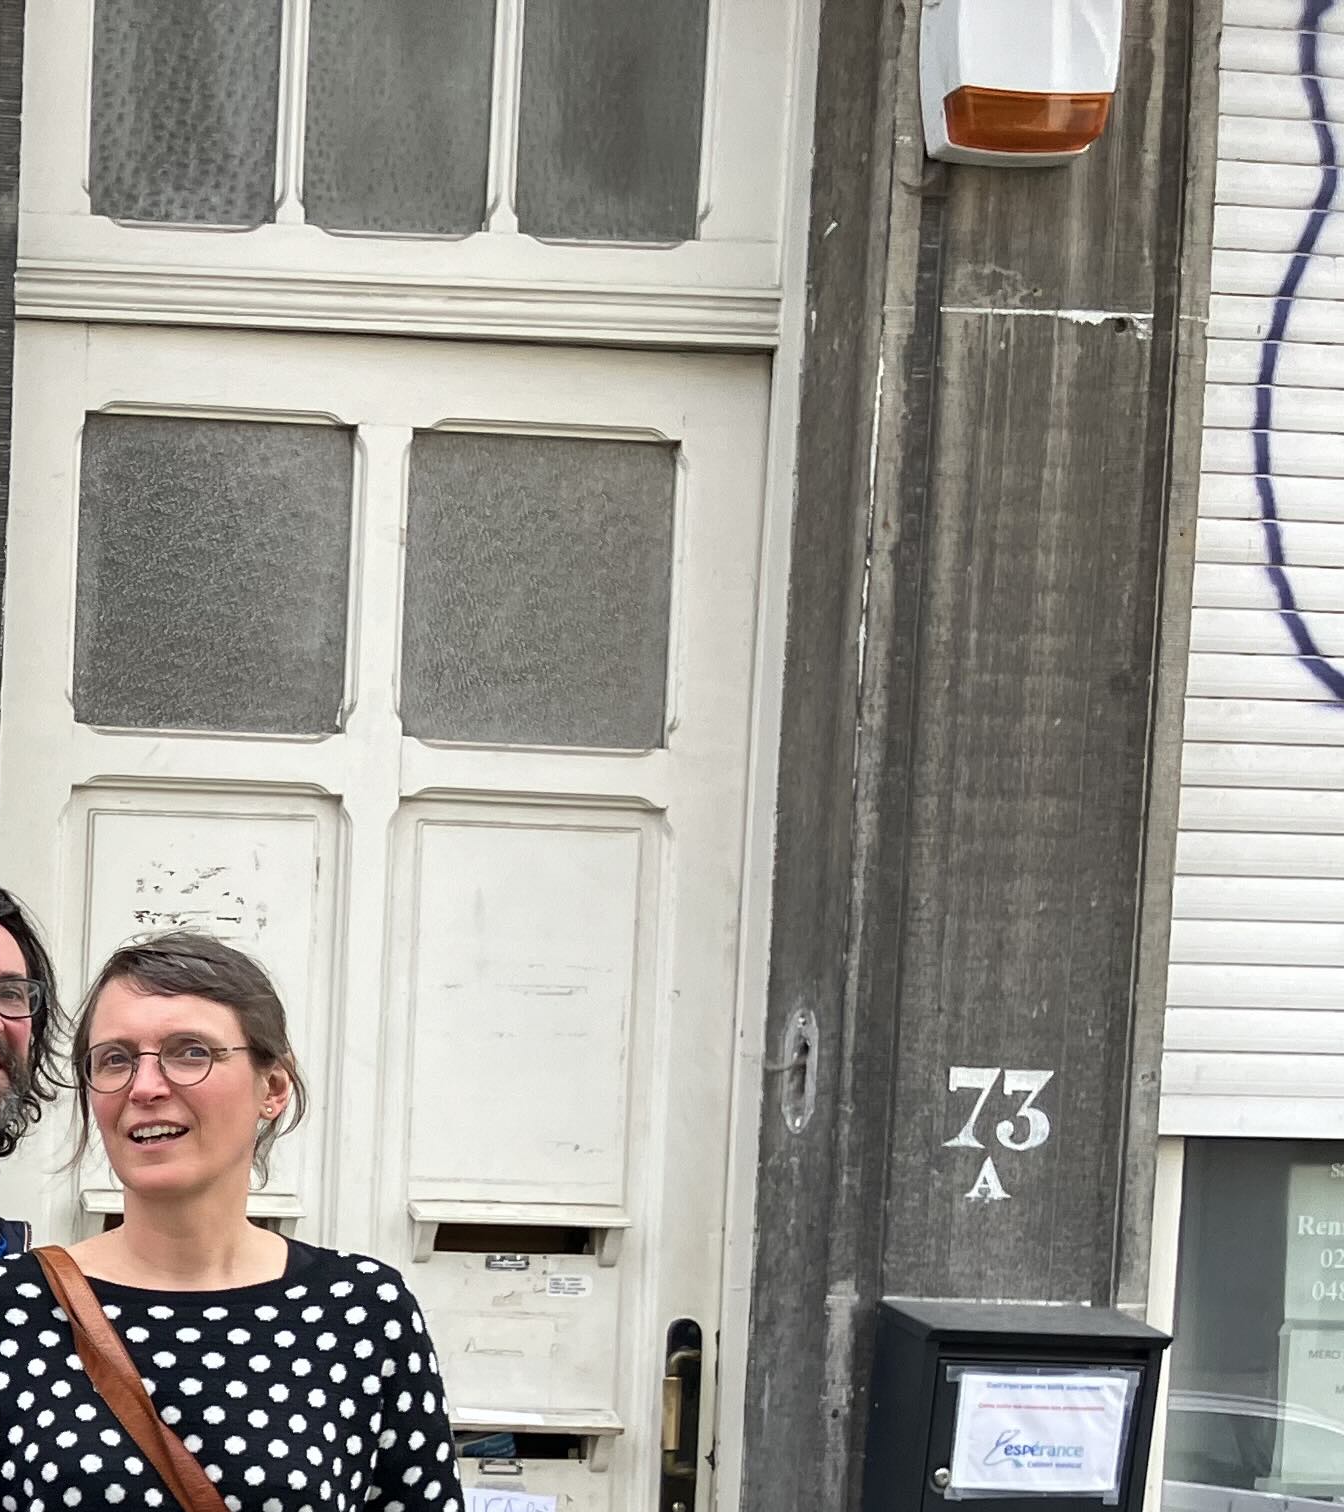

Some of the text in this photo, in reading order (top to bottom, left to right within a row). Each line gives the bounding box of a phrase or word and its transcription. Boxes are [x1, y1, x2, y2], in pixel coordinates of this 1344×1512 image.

[941, 1066, 1055, 1152] 73
[964, 1156, 1011, 1201] A
[1297, 1215, 1344, 1236] Ren
[1312, 1280, 1344, 1301] 048
